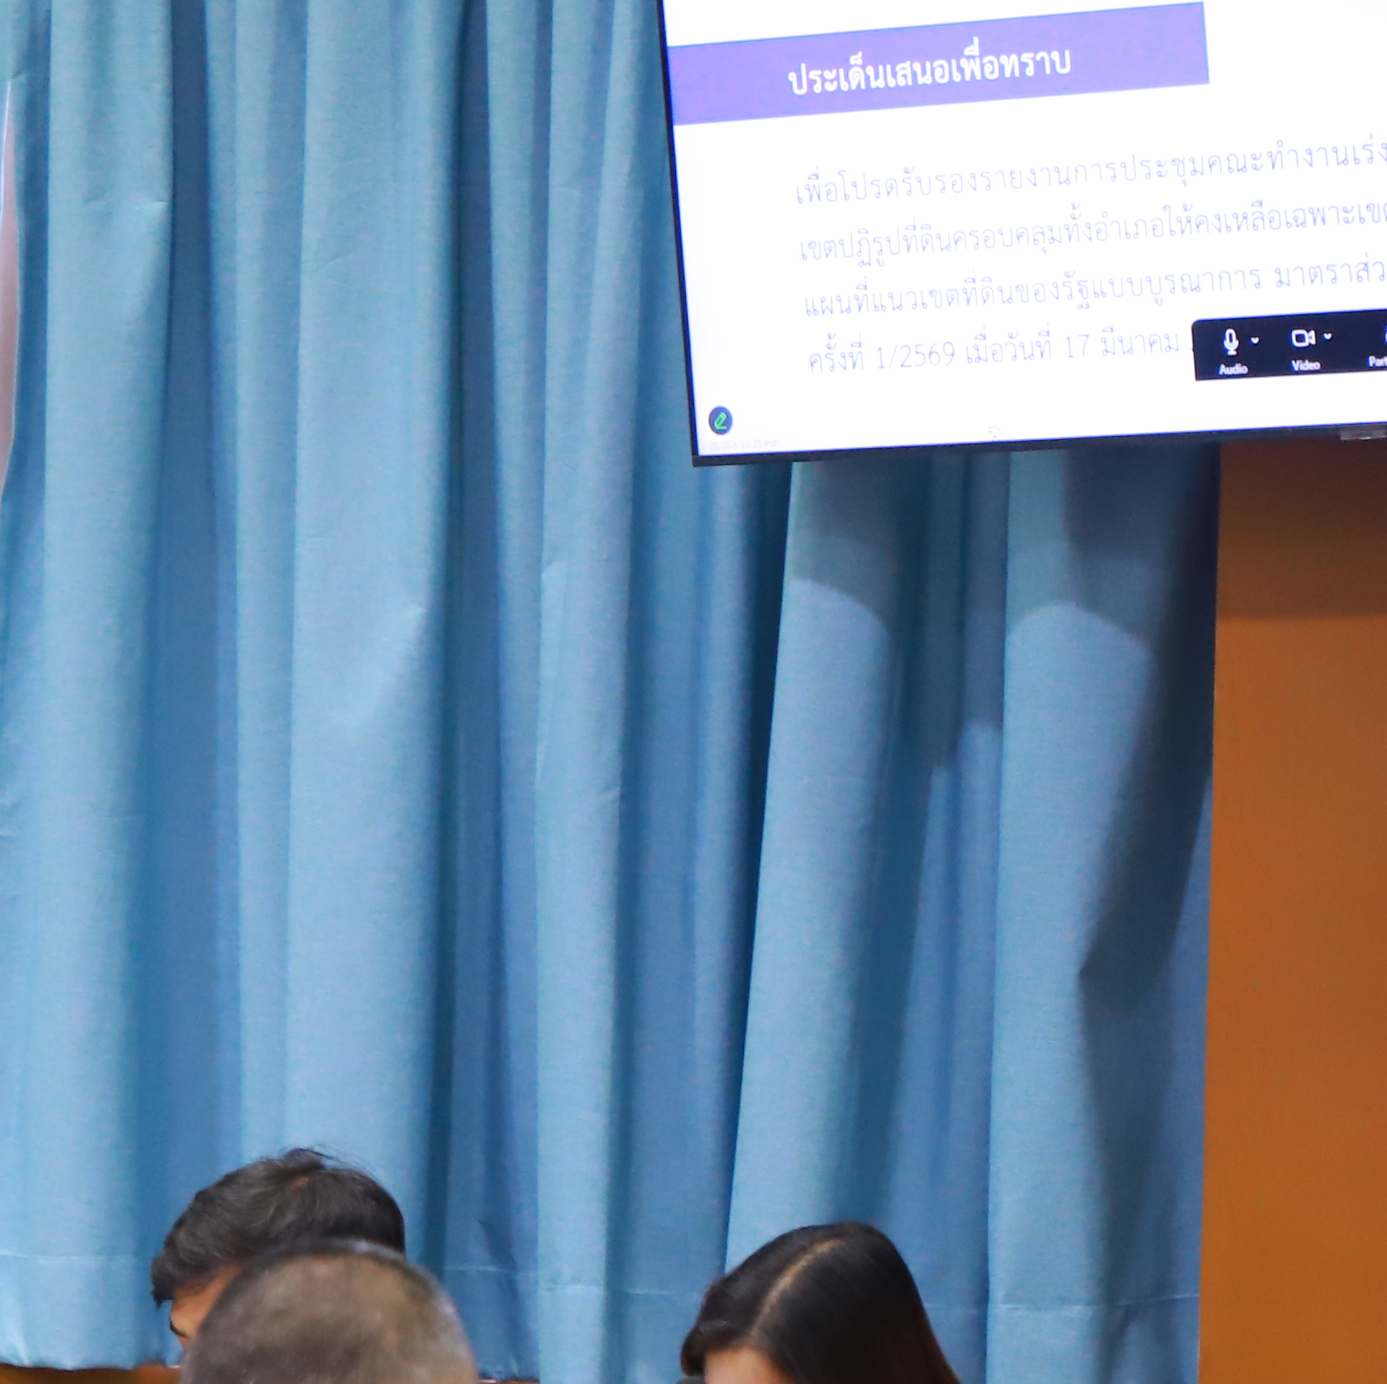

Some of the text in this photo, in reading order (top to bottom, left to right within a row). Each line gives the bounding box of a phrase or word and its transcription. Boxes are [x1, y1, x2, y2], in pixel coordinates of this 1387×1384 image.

[788, 36, 1071, 95] ประเด็นเสนอเพื่อทราบ
[809, 322, 1179, 372] ครั้งที่ 1/2569 เมื่อวันที่ 17 มีนาคม
[1219, 364, 1248, 375] Audio
[1292, 360, 1321, 371] Video
